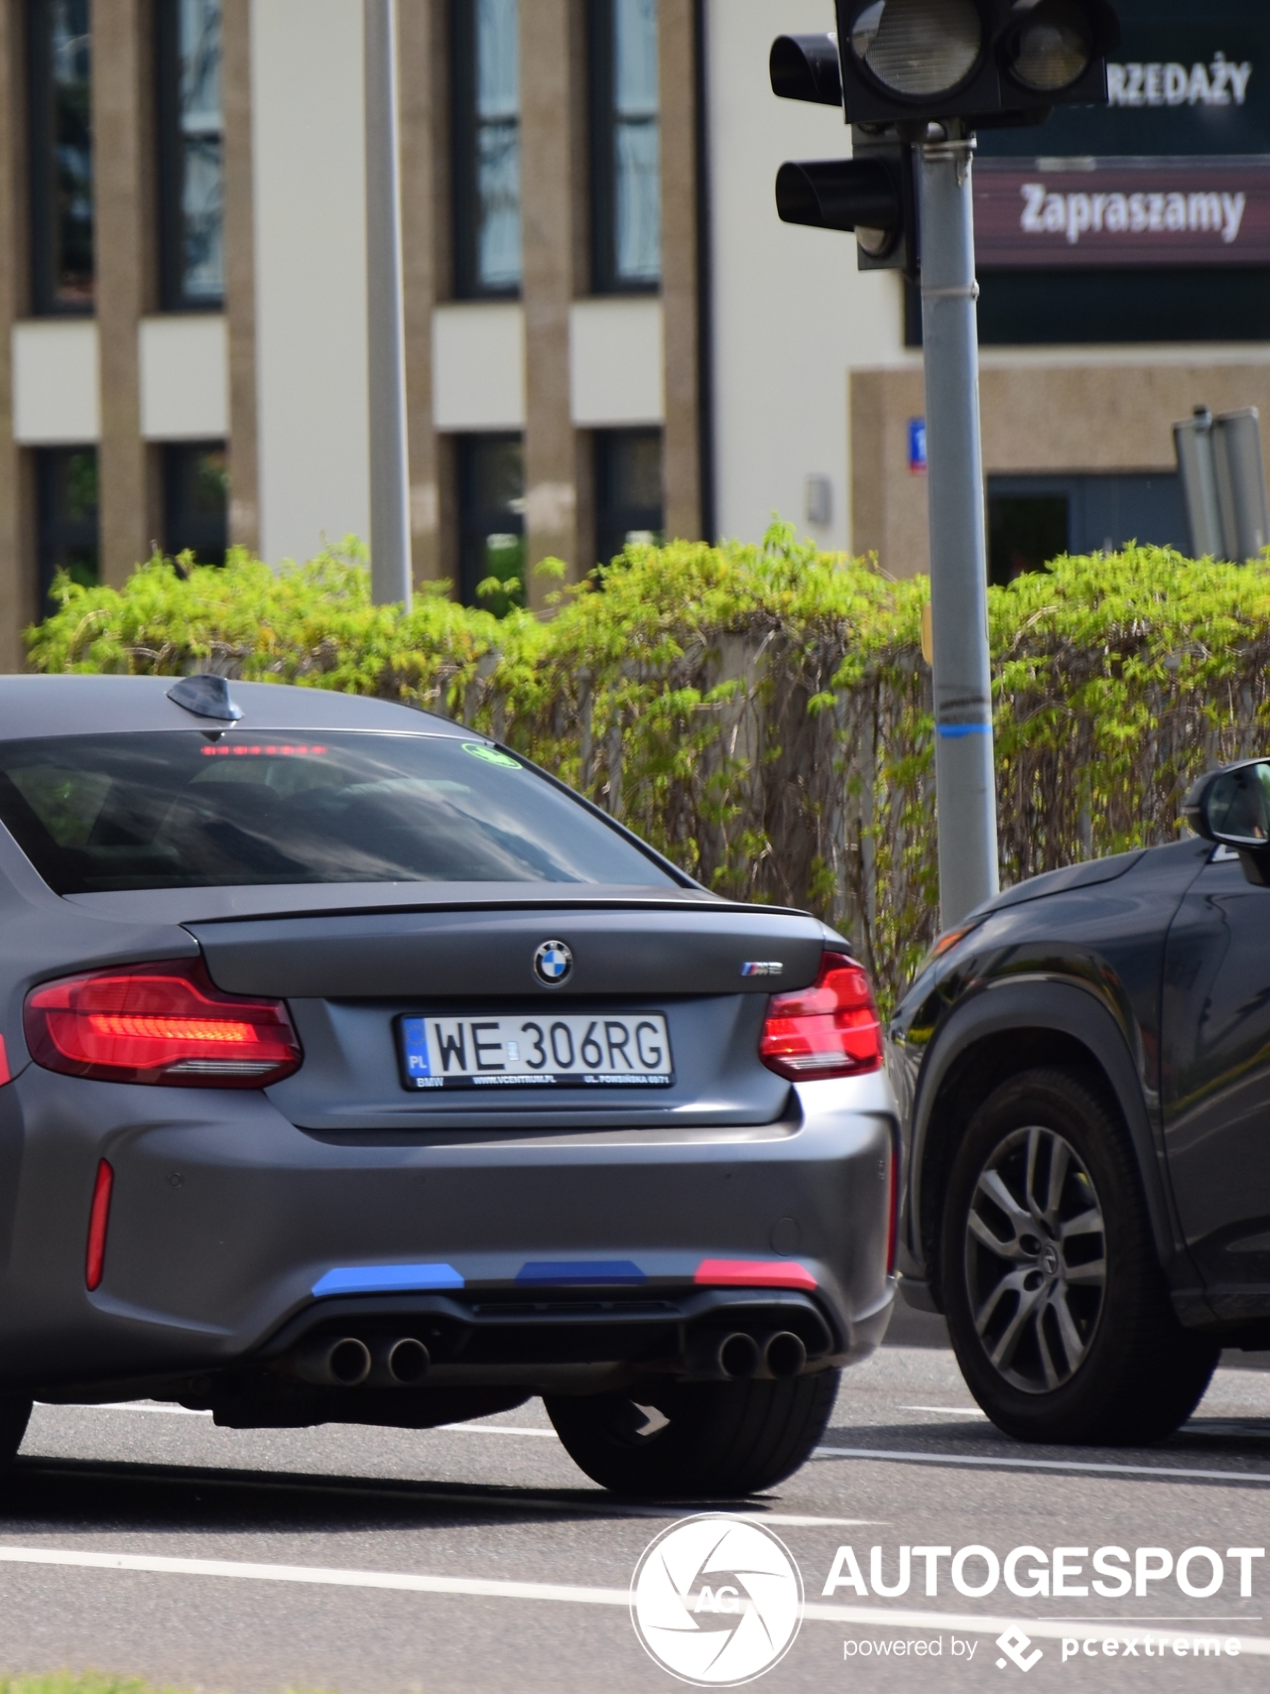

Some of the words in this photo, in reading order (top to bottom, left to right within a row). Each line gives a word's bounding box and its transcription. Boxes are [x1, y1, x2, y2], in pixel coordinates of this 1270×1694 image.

[1106, 51, 1252, 107] RZEDAŻY
[1020, 183, 1246, 244] Zapraszamy
[409, 1055, 428, 1070] PL
[434, 1021, 506, 1072] WE
[521, 1020, 663, 1070] 306RG
[416, 1077, 444, 1088] BMW
